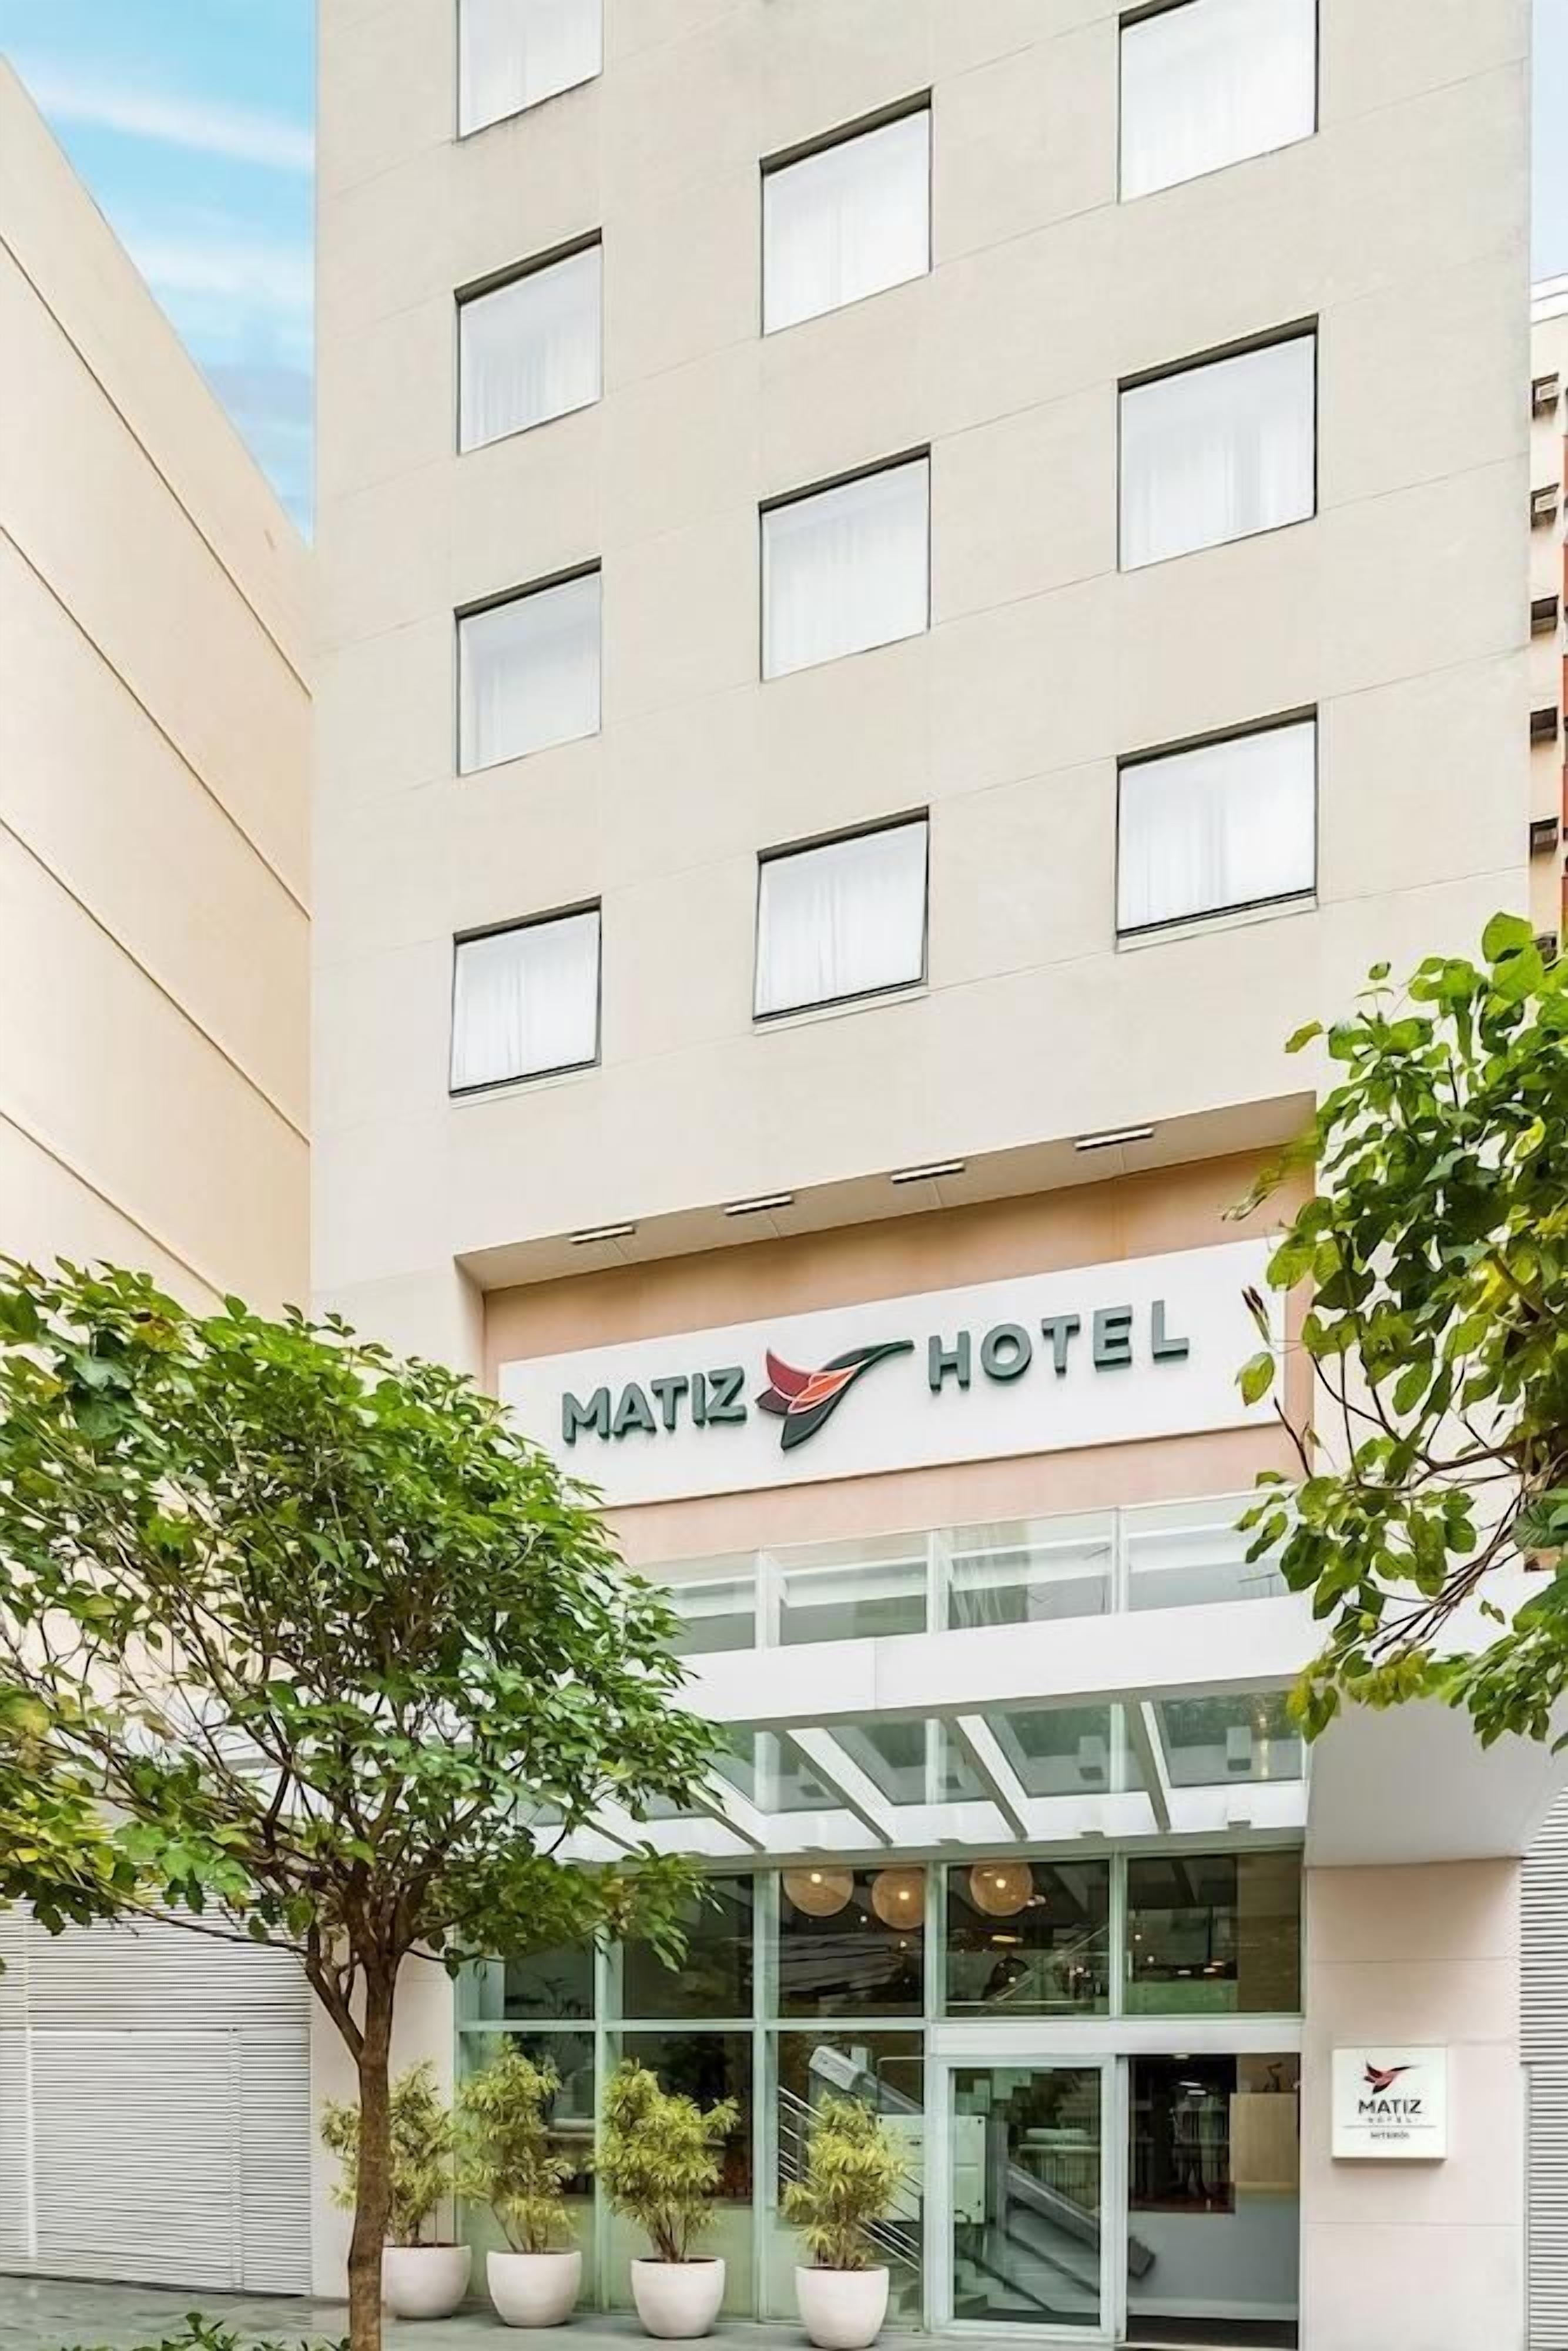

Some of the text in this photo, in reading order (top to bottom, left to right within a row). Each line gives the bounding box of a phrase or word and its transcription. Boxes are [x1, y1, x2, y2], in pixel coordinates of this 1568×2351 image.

[562, 1301, 1189, 1444] MATIZ HOTEL
[1358, 2099, 1422, 2114] MATIZ
